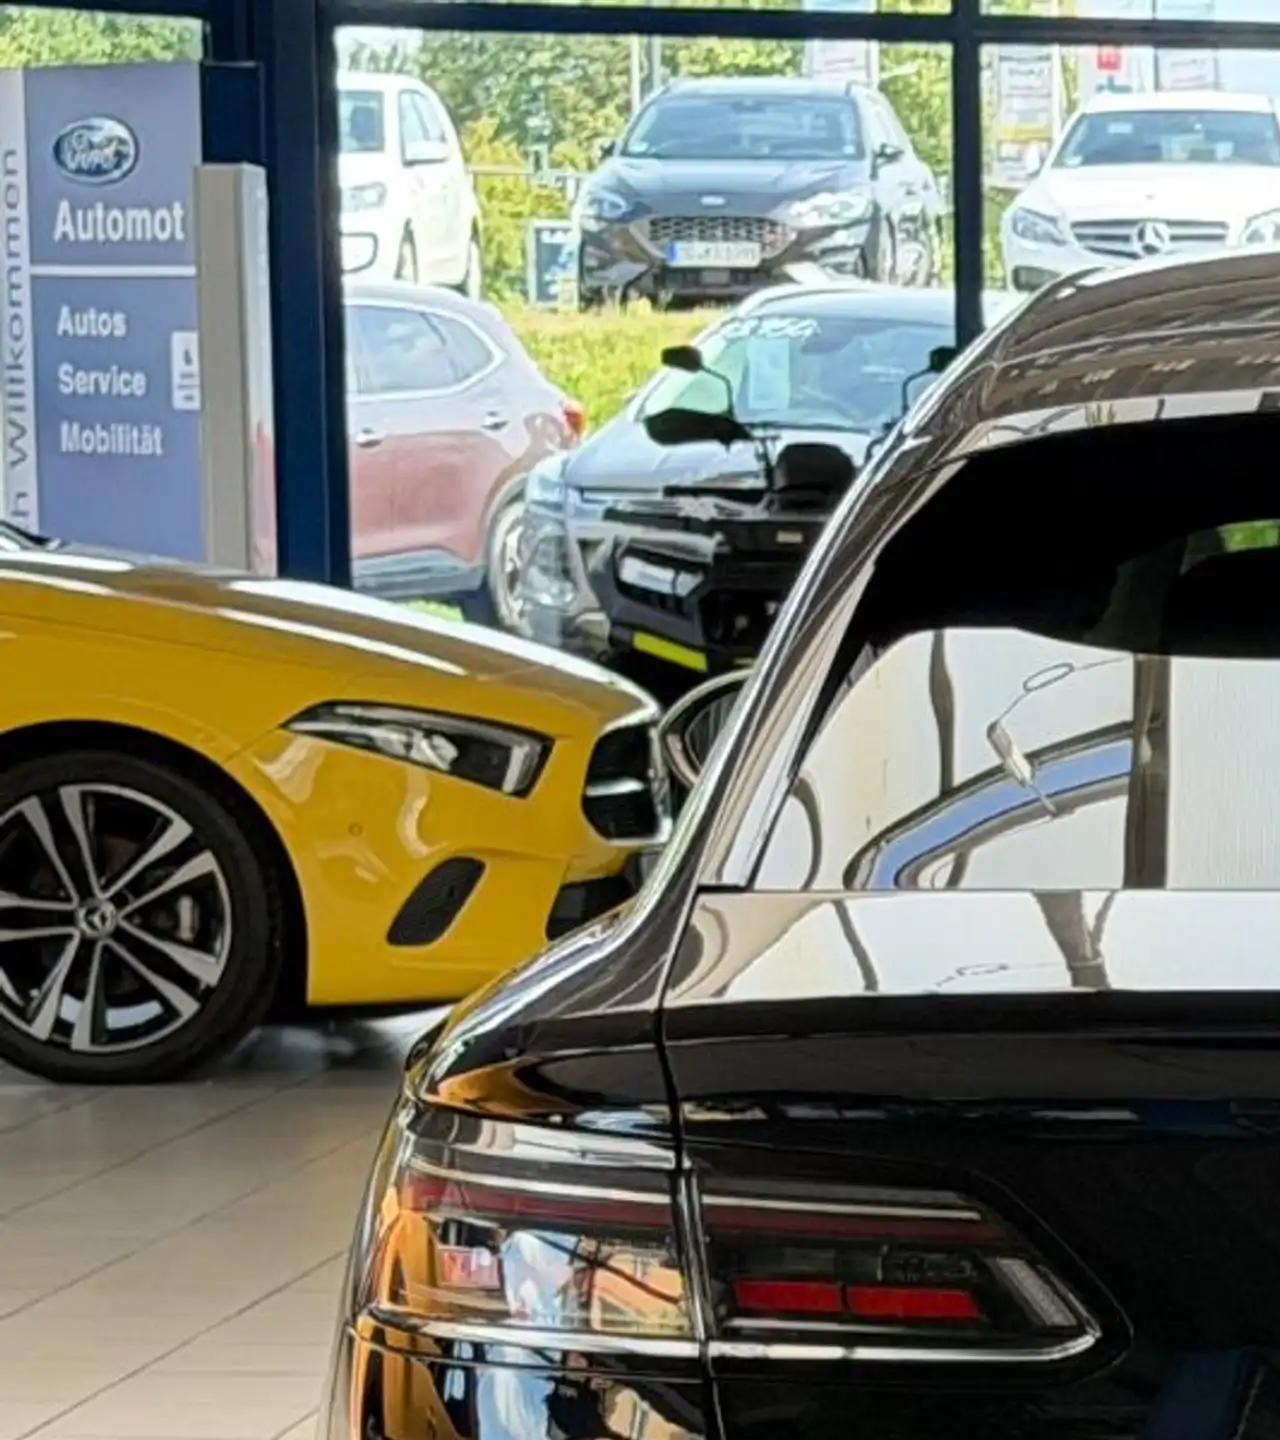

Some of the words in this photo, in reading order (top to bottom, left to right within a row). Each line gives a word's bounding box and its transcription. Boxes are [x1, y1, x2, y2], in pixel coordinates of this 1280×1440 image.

[53, 199, 185, 242] Automot
[57, 305, 127, 337] Autos
[58, 362, 147, 397] Service
[60, 420, 164, 456] Mobilität
